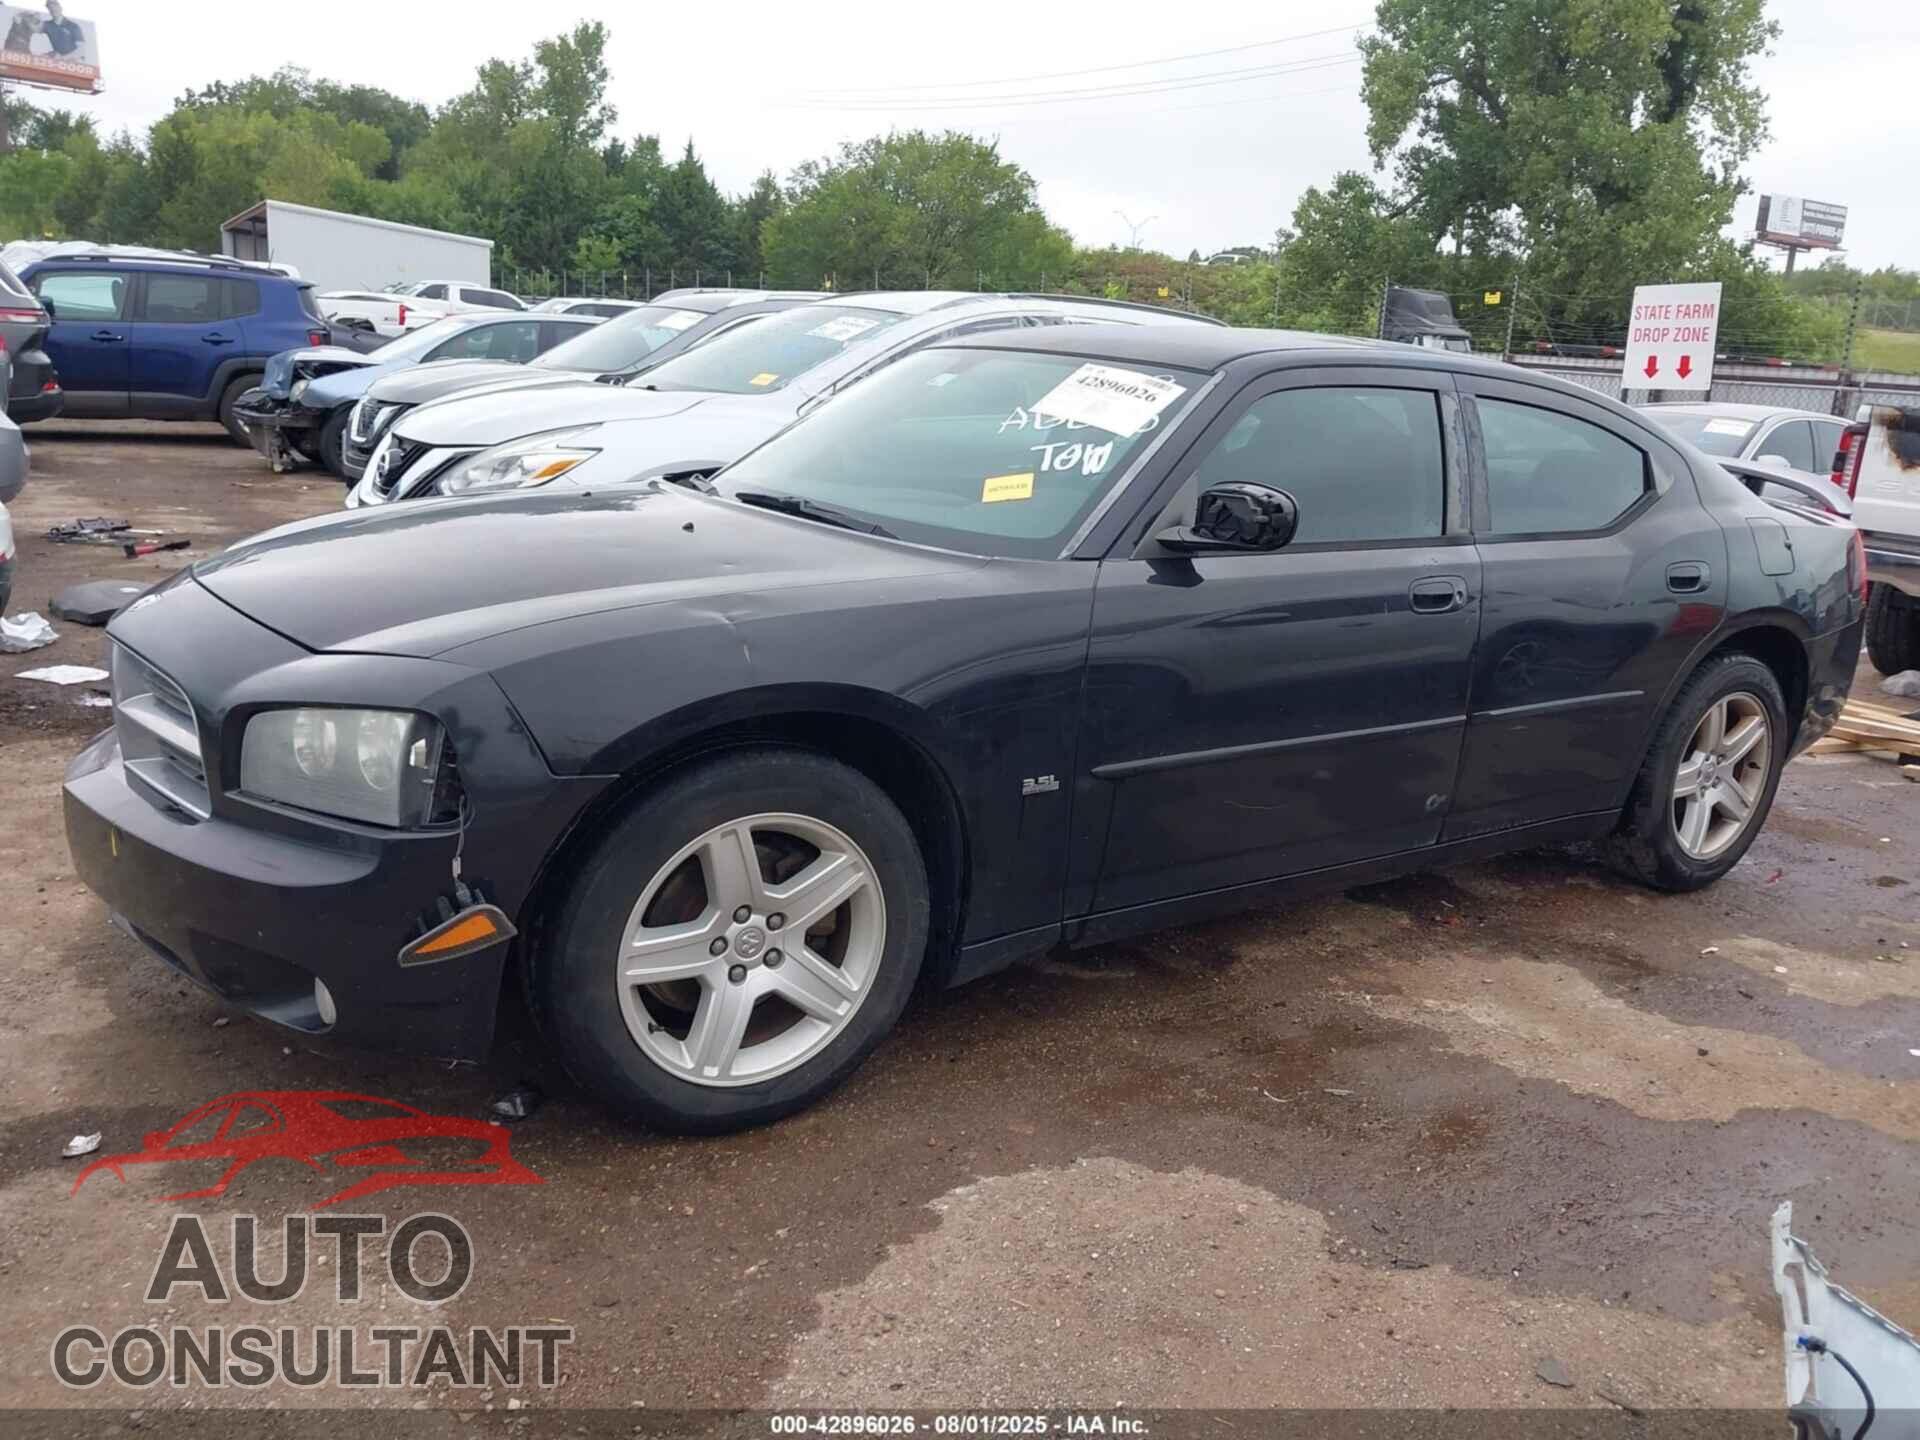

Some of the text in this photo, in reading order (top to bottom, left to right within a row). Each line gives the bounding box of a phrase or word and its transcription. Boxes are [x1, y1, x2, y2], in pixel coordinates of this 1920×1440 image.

[1634, 303, 1715, 321] STATE FARM
[1633, 326, 1710, 343] DROP ZONE
[1076, 374, 1158, 404] 42896026
